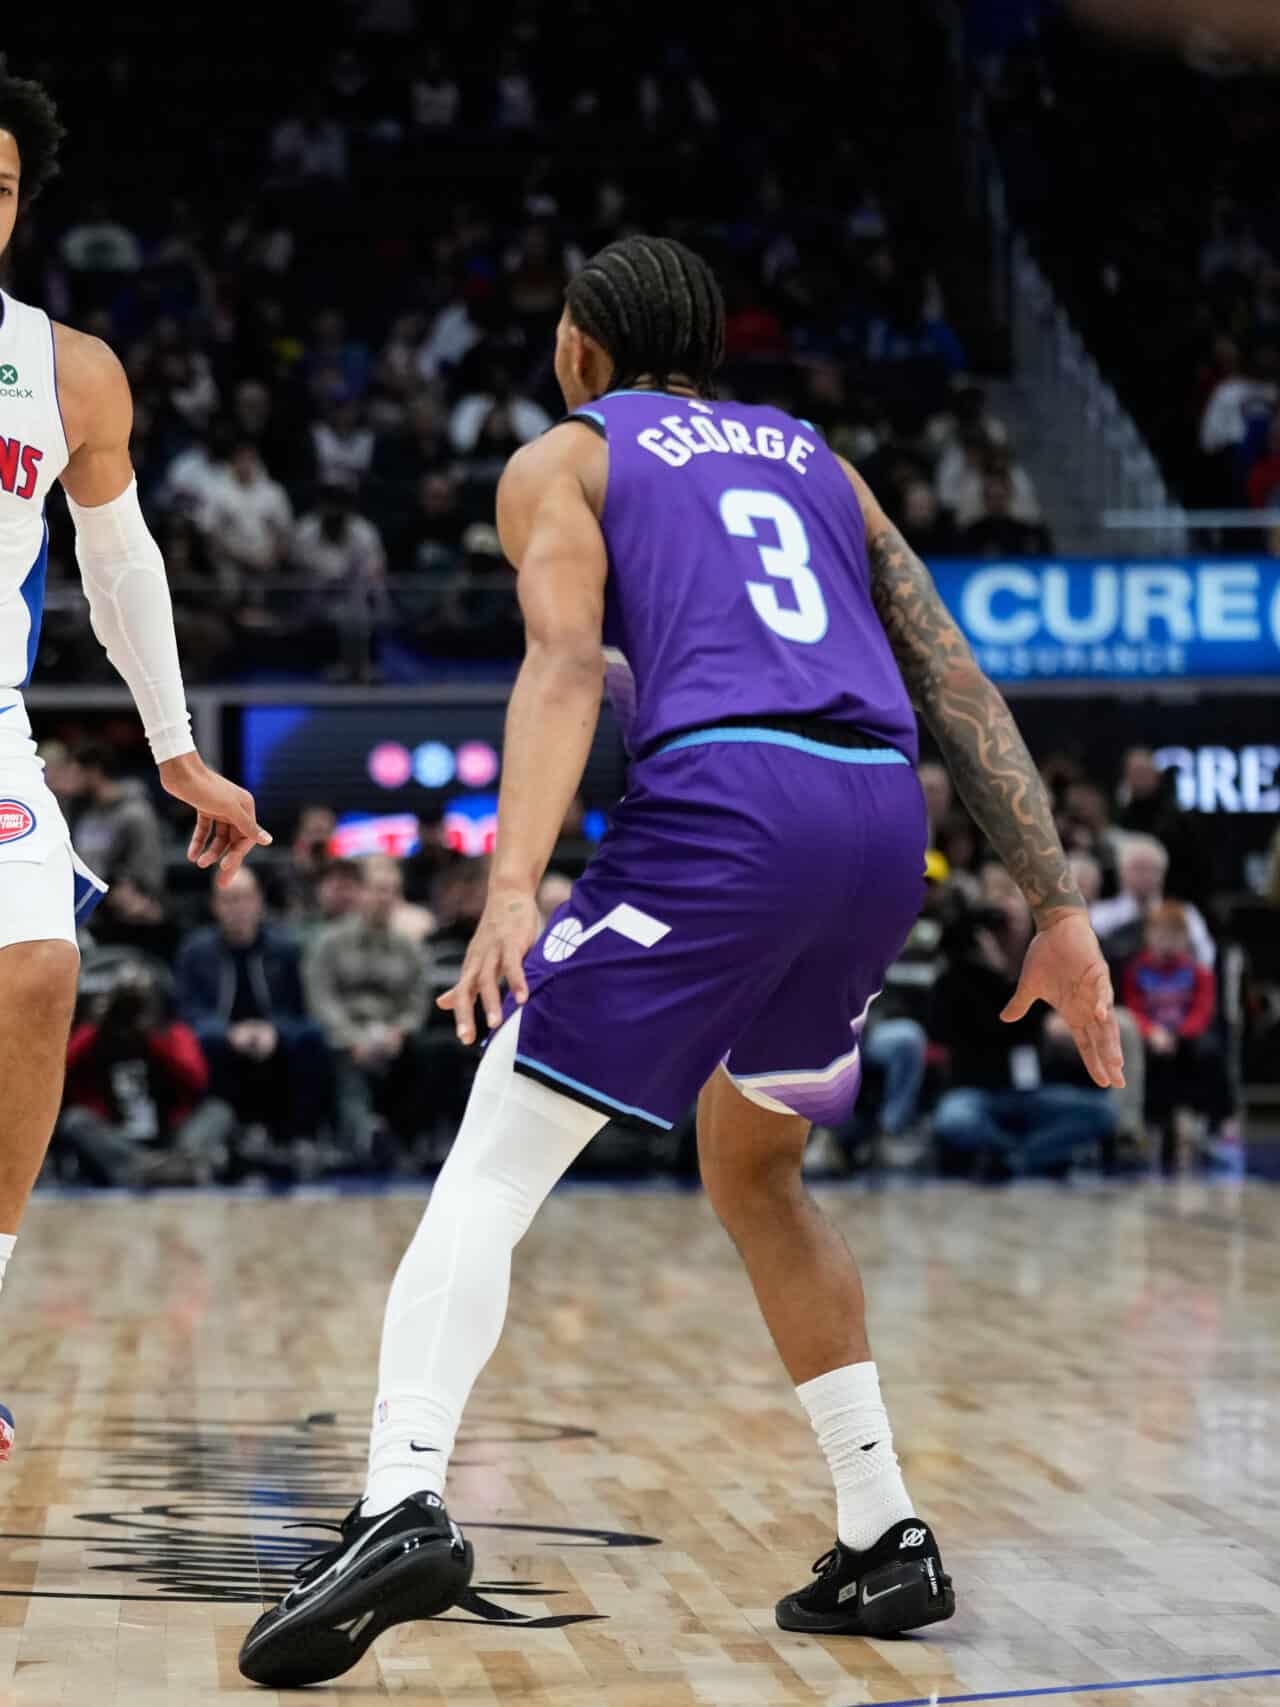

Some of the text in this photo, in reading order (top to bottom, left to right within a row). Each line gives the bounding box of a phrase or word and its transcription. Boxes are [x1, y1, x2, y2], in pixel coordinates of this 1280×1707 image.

[637, 415, 815, 475] GEORGE
[719, 488, 829, 645] 3
[961, 563, 1262, 645] CURE
